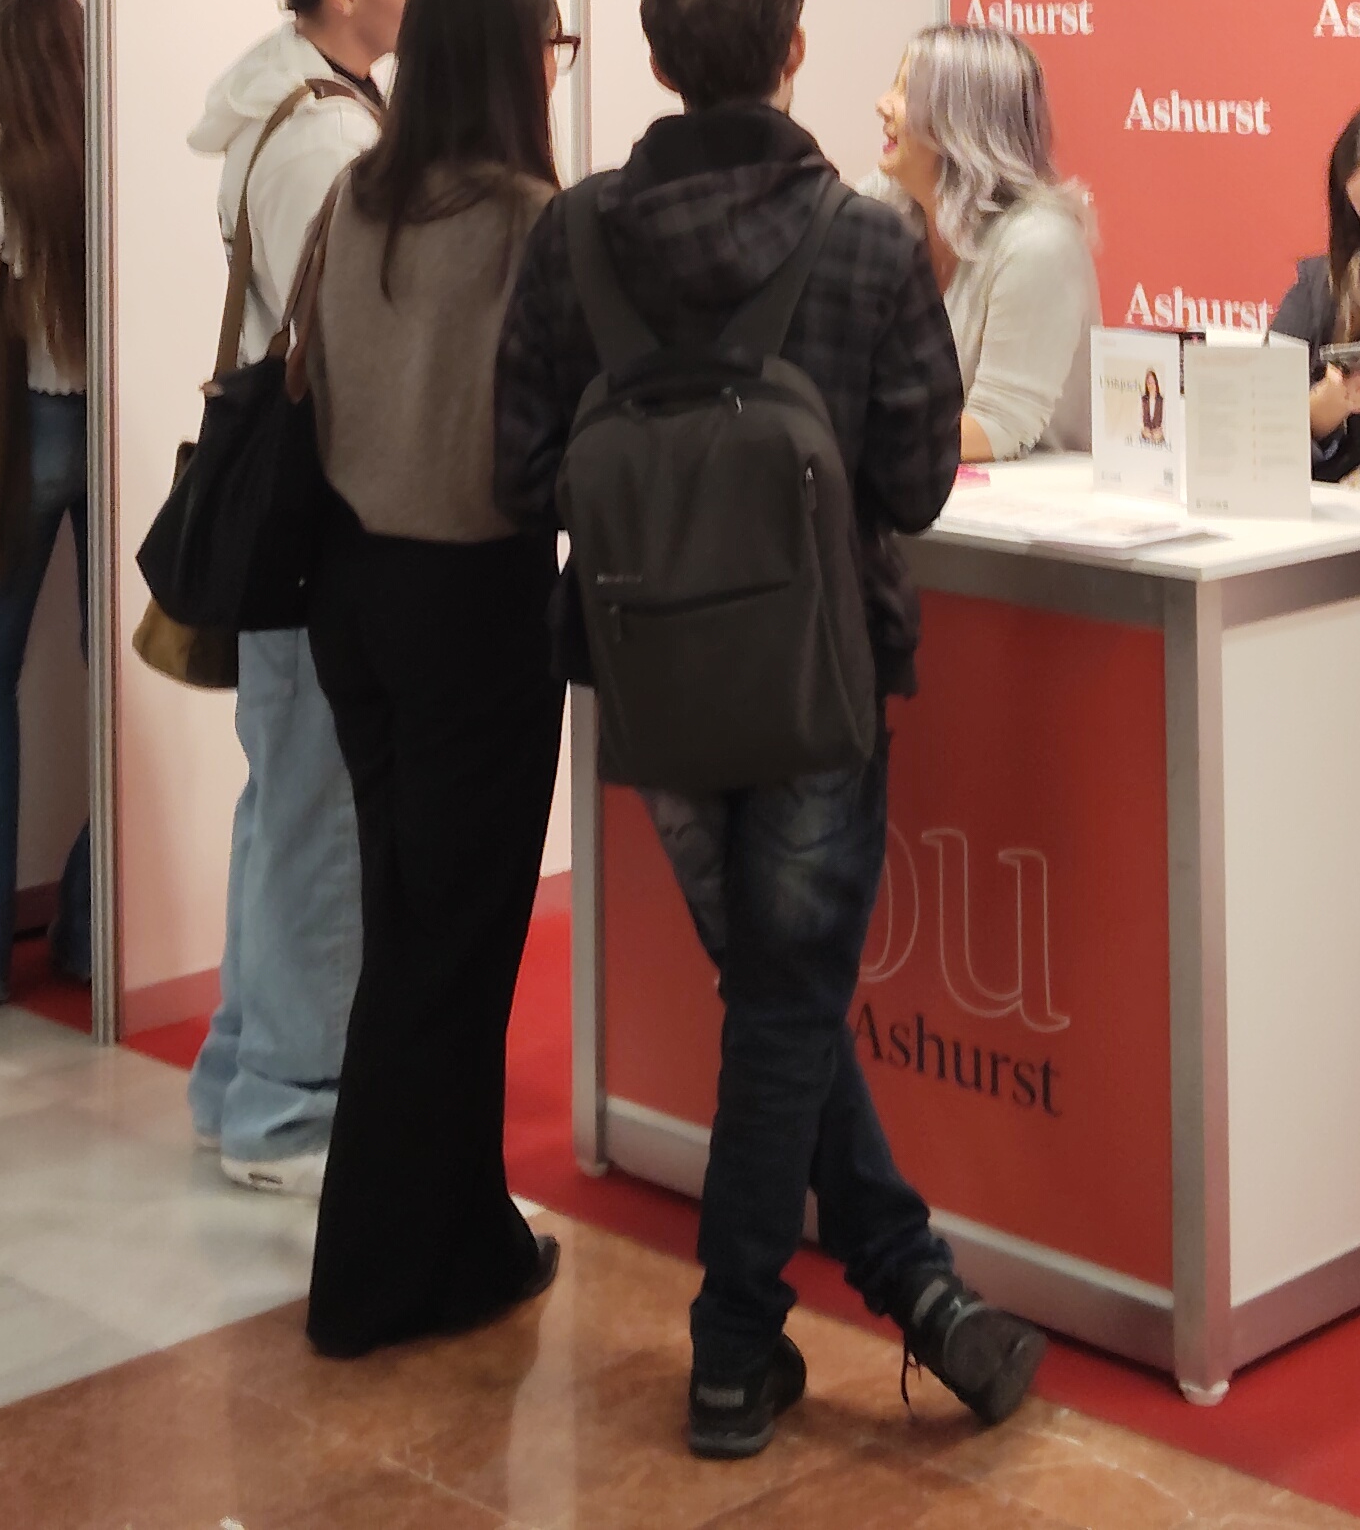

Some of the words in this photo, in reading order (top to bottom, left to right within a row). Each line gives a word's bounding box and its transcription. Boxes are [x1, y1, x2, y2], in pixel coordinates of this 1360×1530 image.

[1123, 88, 1271, 135] Ashurst
[1125, 282, 1274, 331] Ashurst
[854, 1002, 1063, 1118] Ashurst
